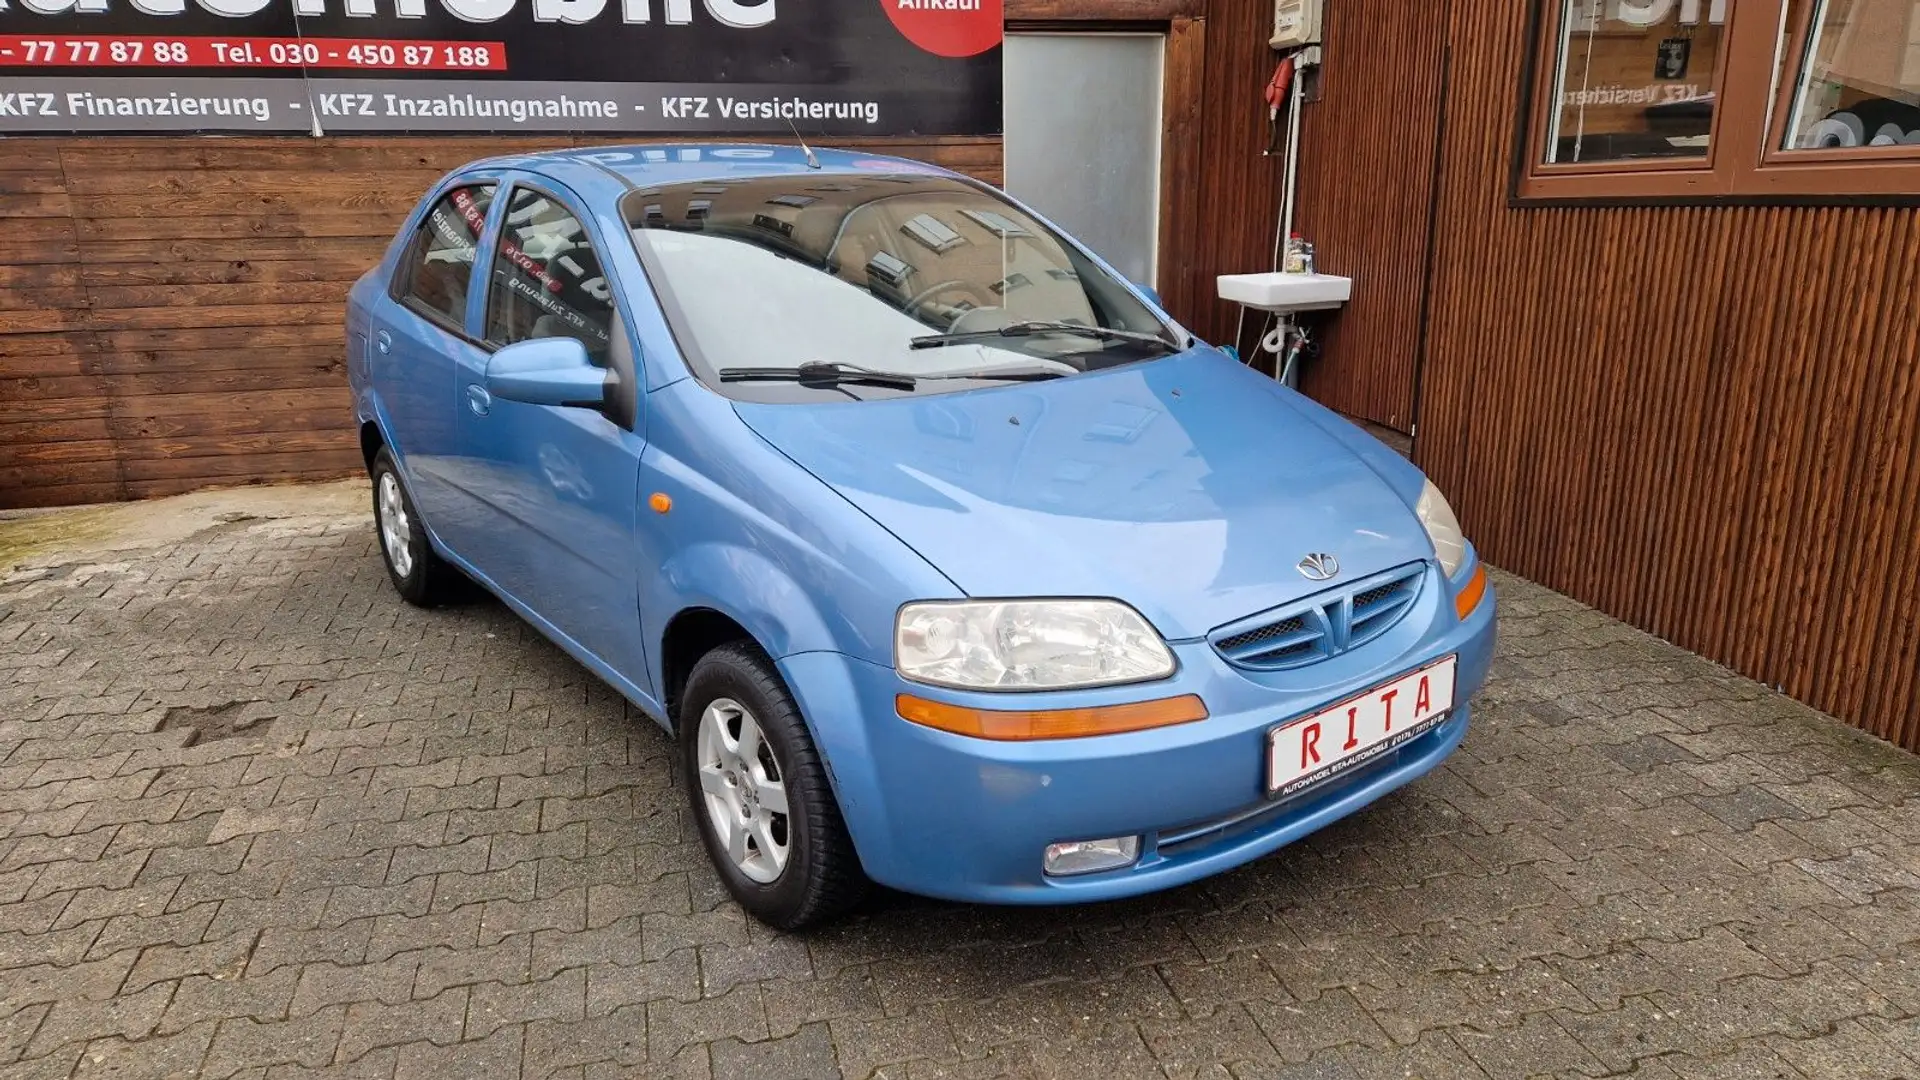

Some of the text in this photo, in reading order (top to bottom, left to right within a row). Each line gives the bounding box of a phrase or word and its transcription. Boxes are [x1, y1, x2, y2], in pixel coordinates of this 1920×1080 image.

[20, 41, 56, 62] 77
[65, 41, 100, 62] 77
[109, 41, 143, 63] 87
[153, 42, 189, 63] 88
[211, 43, 262, 64] Tel.
[269, 43, 319, 65] 030
[347, 44, 395, 66] 450
[403, 45, 434, 66] 87
[443, 46, 490, 67] 188
[0, 93, 59, 116] KFZ
[66, 92, 270, 122] Finanzierung
[320, 93, 377, 117] KFZ
[383, 93, 619, 124] Inzahlungnahme
[661, 97, 710, 119] KFZ
[716, 97, 879, 124] Versicherung
